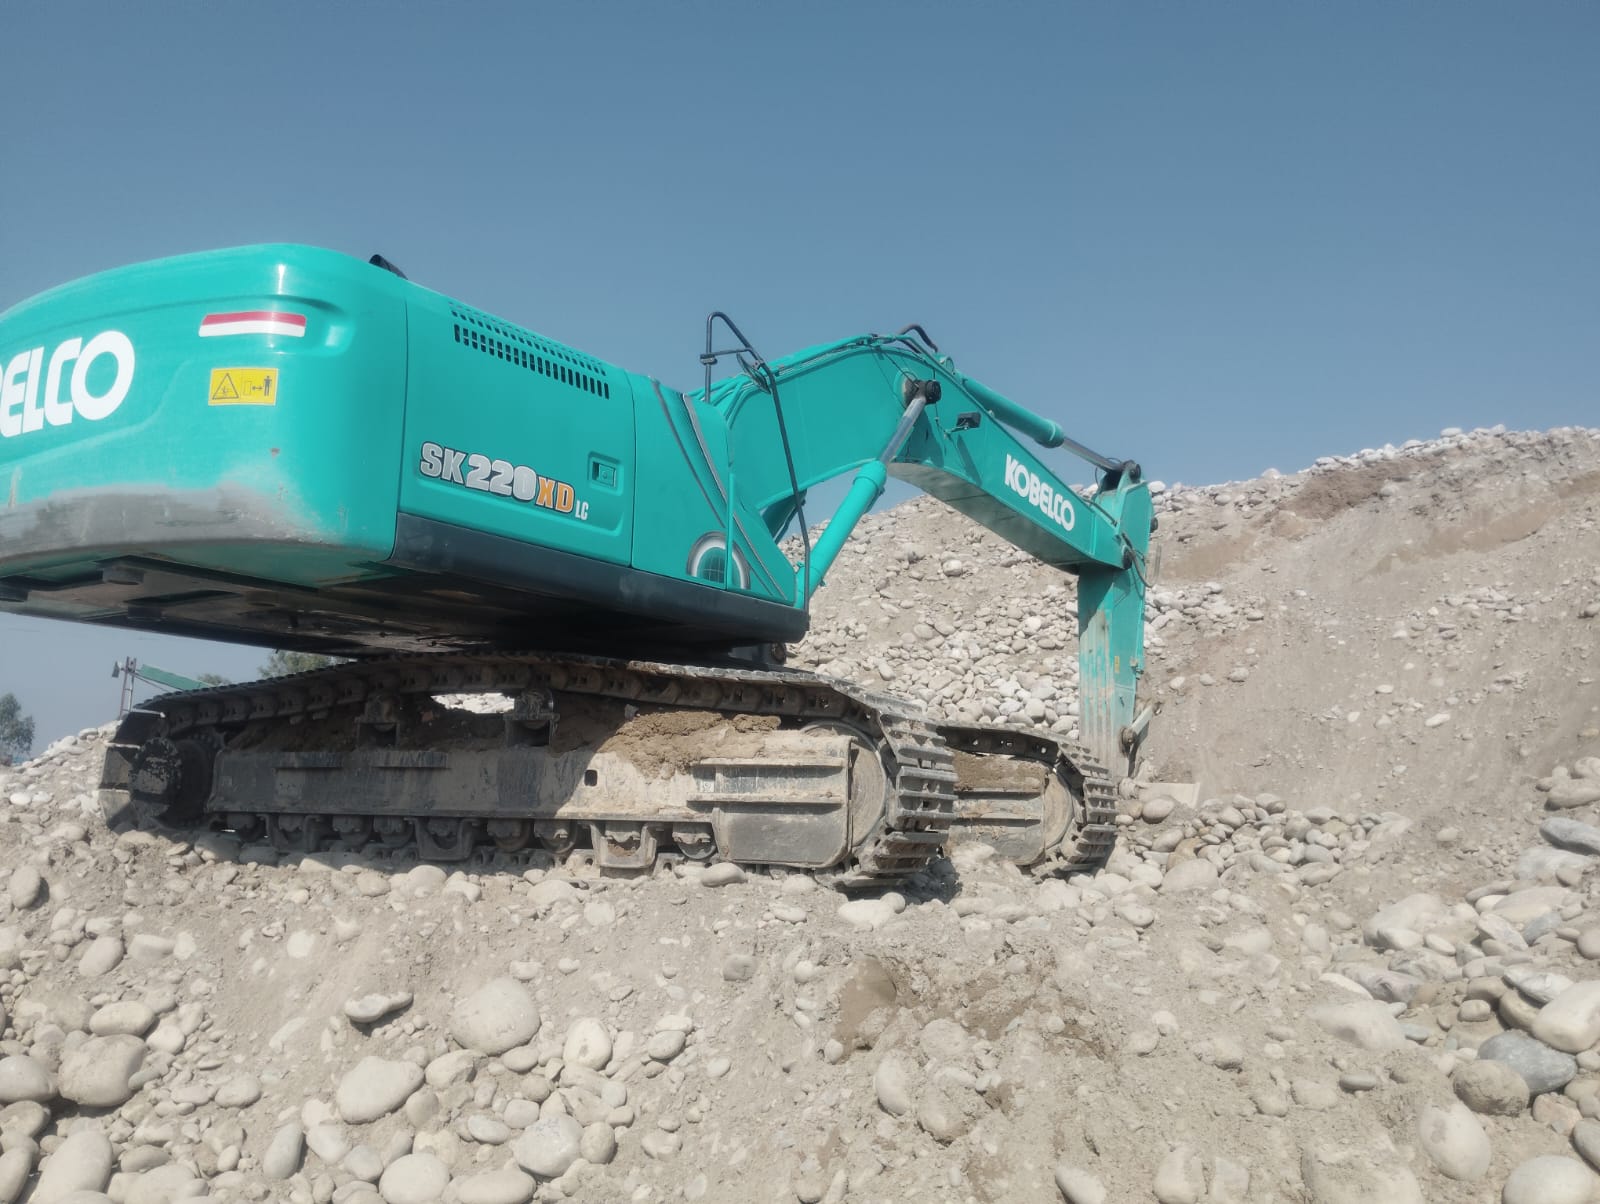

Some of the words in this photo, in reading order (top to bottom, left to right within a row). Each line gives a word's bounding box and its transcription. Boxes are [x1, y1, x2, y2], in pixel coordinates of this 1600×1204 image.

[0, 330, 135, 437] ELCO
[575, 500, 589, 520] LC
[1004, 453, 1075, 531] KOBELCO
